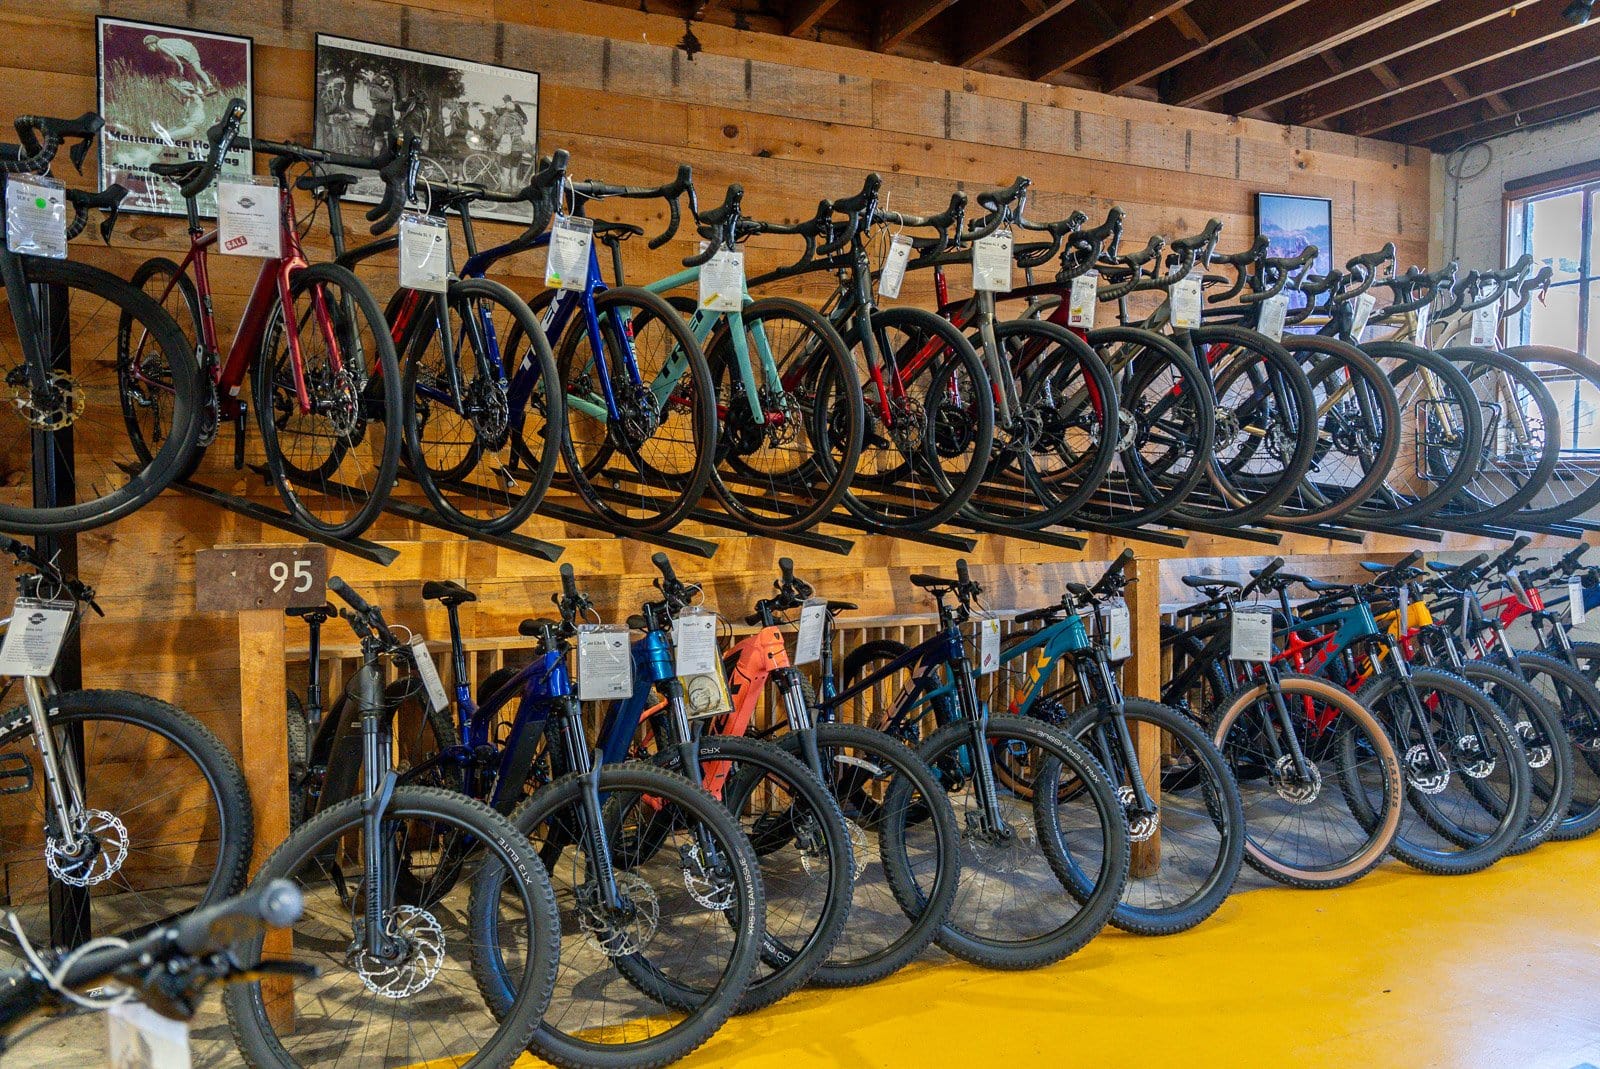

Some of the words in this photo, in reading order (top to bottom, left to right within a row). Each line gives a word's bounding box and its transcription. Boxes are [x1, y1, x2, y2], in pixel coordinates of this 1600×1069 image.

[225, 236, 247, 250] SALE
[519, 289, 567, 372] TEK
[269, 560, 313, 593] 95
[0, 707, 60, 738] AXXS
[1493, 713, 1510, 733] COMP
[1037, 730, 1063, 746] ISSUE
[700, 747, 721, 755] XR3
[1062, 744, 1084, 765] TEAM
[1387, 756, 1399, 808] MAXXIS
[497, 837, 520, 863] ELITE
[518, 864, 533, 885] XT3
[739, 857, 752, 884] ISSUE
[746, 884, 756, 913] TEAM
[763, 941, 776, 953] R3
[776, 950, 790, 963] CO
